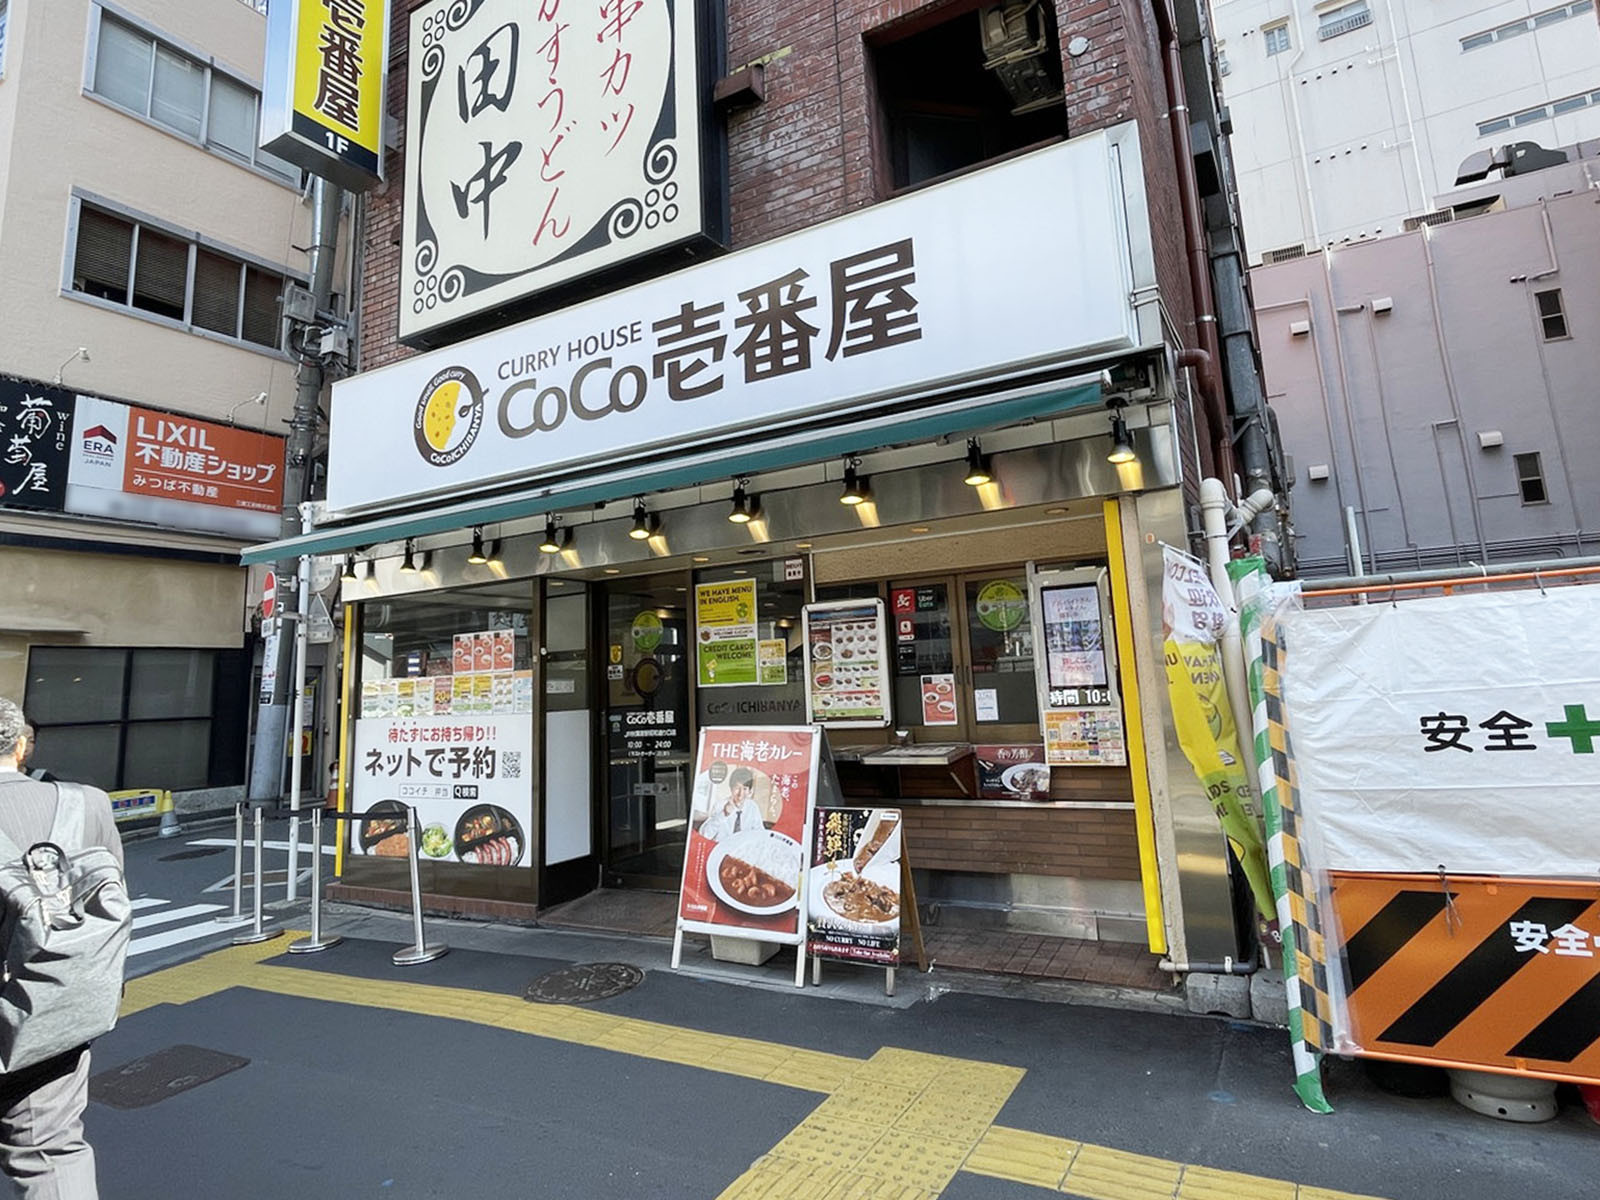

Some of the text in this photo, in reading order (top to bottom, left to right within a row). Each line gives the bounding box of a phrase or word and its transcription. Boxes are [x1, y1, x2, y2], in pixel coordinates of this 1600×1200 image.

[325, 131, 350, 154] 1F
[449, 22, 523, 241] 田中
[497, 320, 643, 381] CURRY HOUSE
[83, 440, 114, 455] ERA
[136, 416, 216, 451] LIXIL
[135, 440, 277, 485] 不動産ショップ
[132, 474, 219, 499] みつば不動産
[1419, 711, 1538, 753] 安全
[364, 745, 497, 780] ネットで予約
[1508, 919, 1594, 958] 安全
